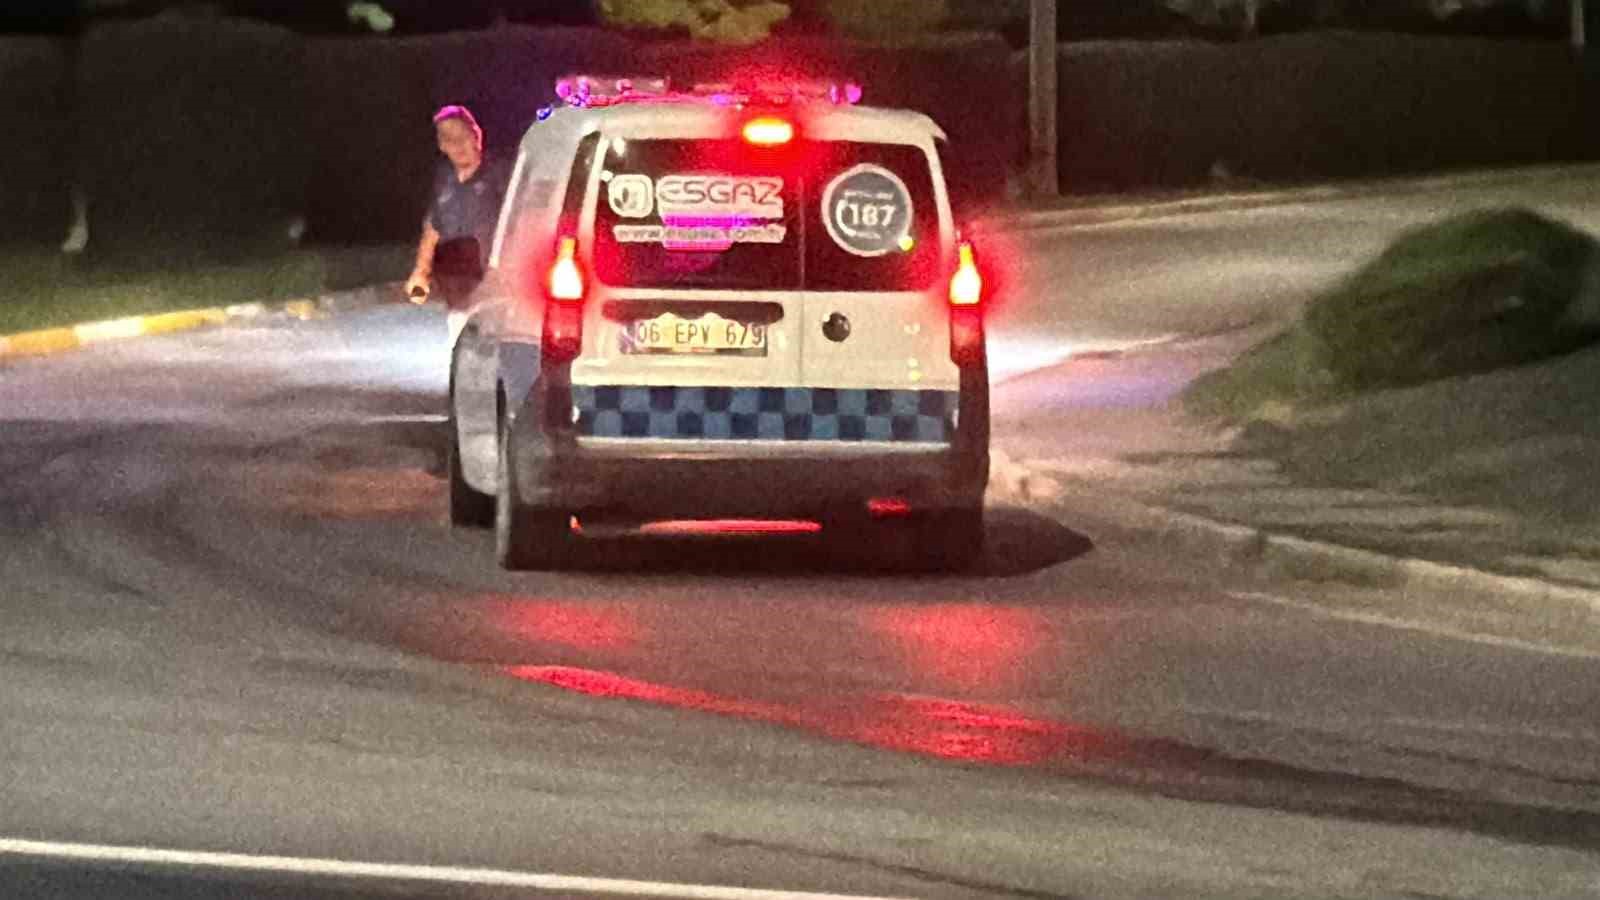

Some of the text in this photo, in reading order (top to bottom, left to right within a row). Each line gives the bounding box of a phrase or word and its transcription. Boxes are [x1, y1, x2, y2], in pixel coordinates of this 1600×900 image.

[659, 180, 781, 205] ESGAZ
[848, 203, 896, 226] 187
[636, 322, 661, 344] 06
